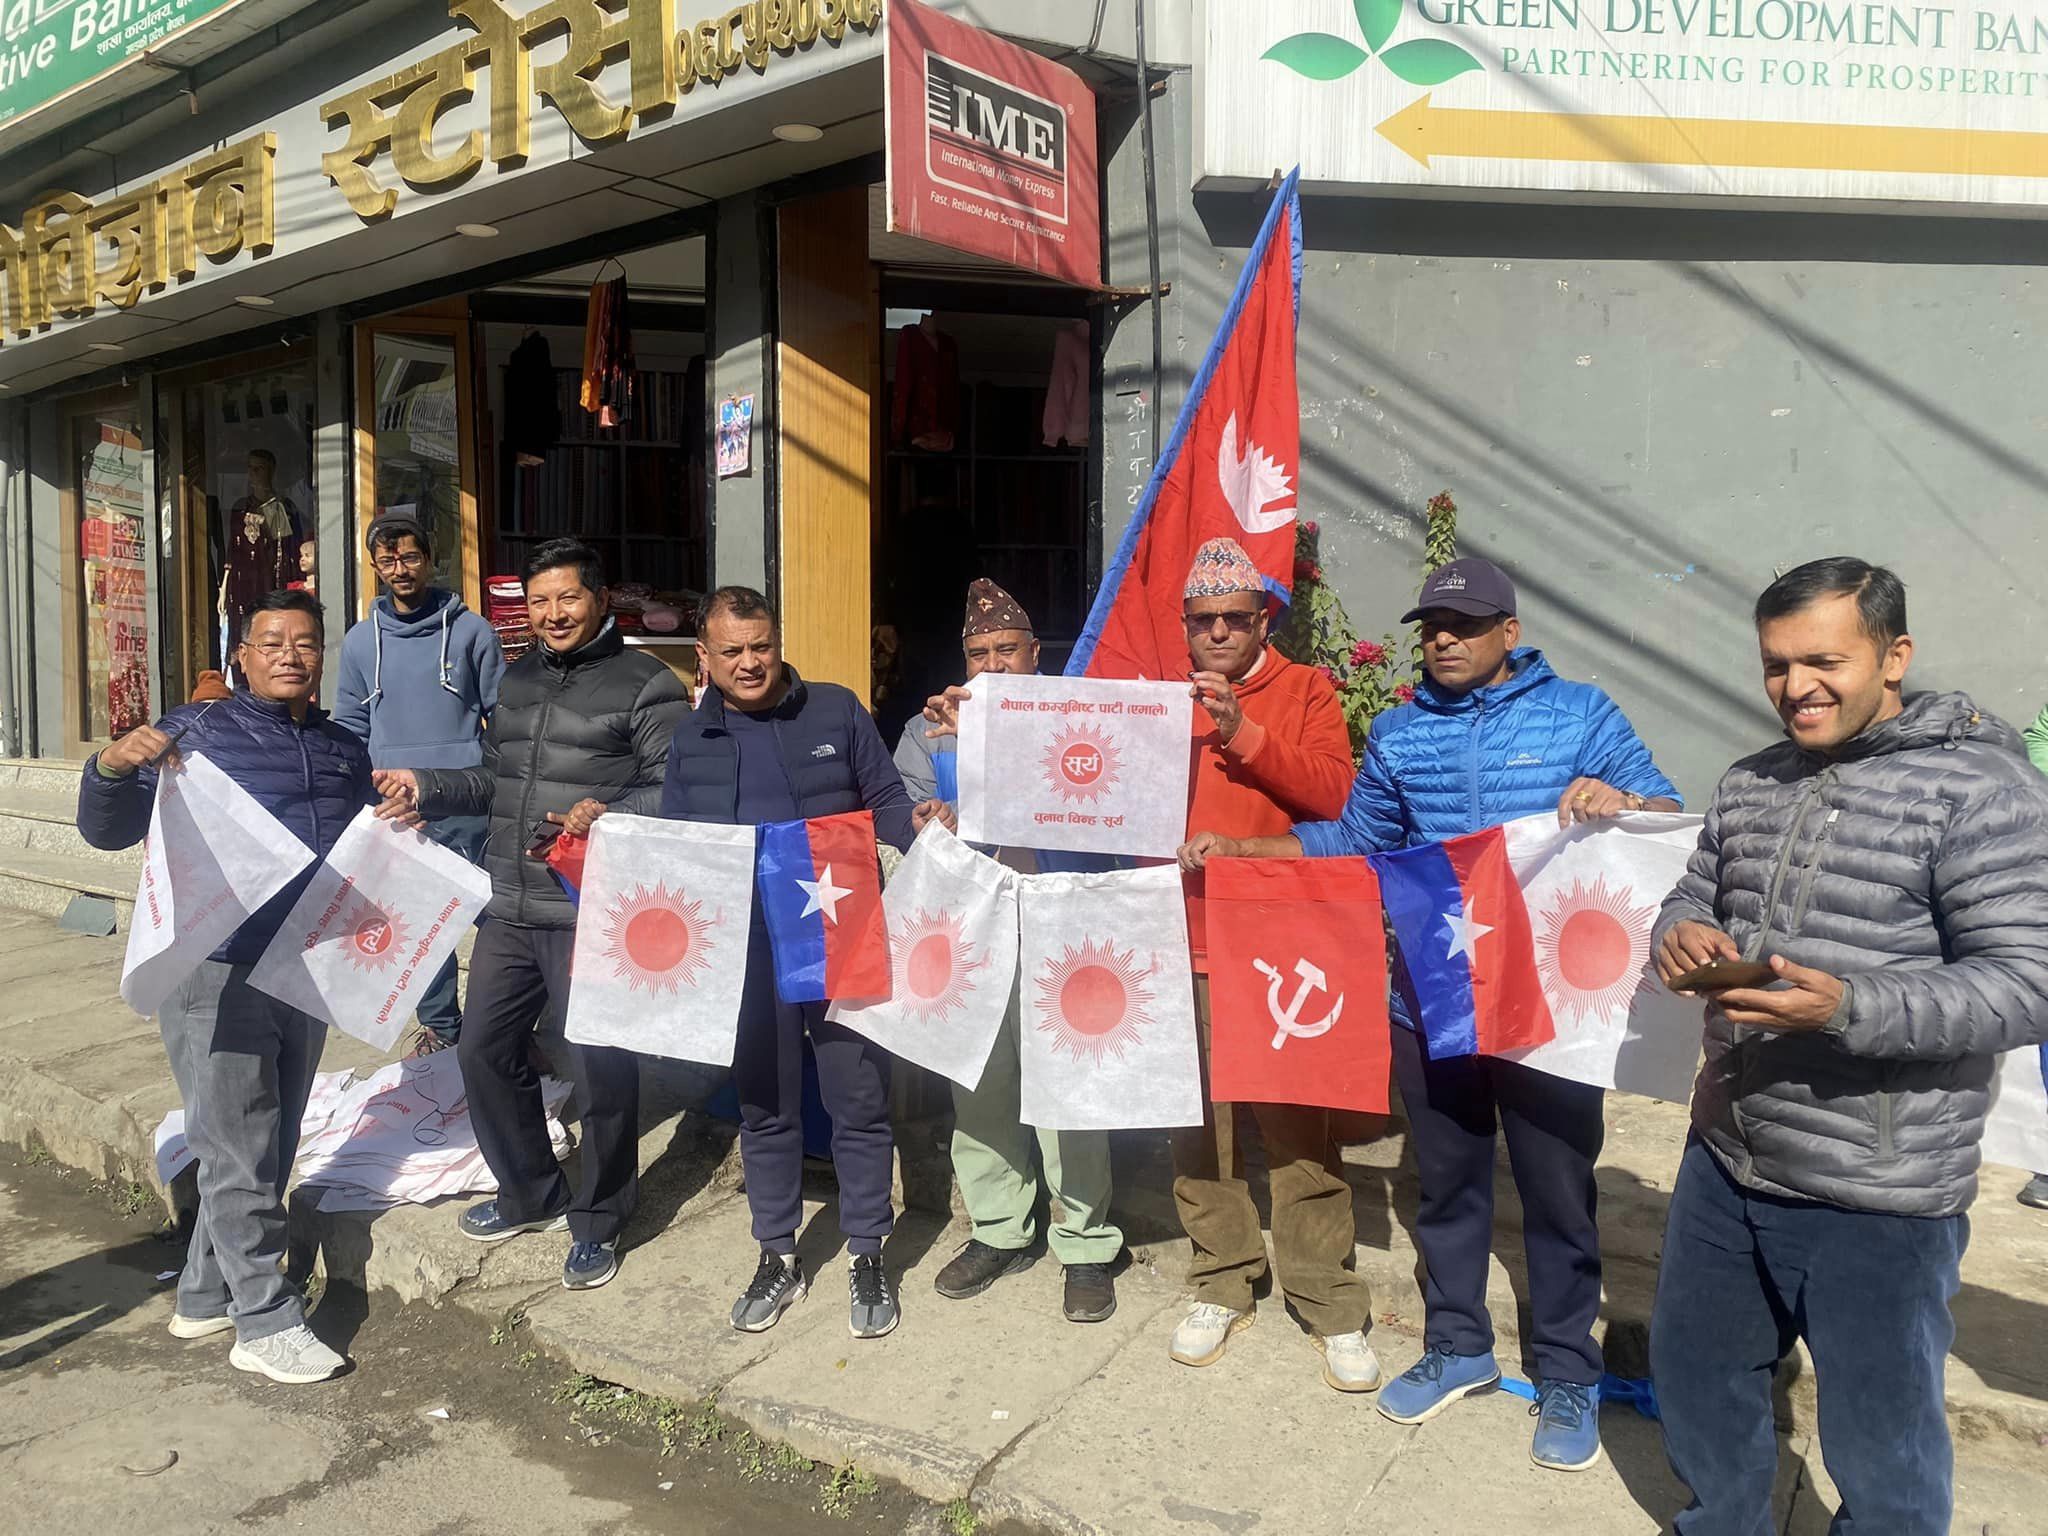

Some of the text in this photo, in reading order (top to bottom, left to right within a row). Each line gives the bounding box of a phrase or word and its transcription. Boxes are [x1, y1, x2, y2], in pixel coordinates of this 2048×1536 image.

[1417, 0, 1579, 31] GREEN
[1604, 0, 1955, 49] DEVELOPMENT
[1501, 46, 2048, 97] PARTNERING FOR PROSPERIT
[952, 83, 1054, 170] IME
[941, 147, 1056, 200] International Money Express
[951, 197, 983, 218] Reliable
[983, 207, 999, 223] And
[1000, 214, 1025, 231] Secure
[1026, 220, 1066, 244] Remittance
[1000, 697, 1034, 712] नेपाल
[1063, 754, 1100, 777] सूर्य
[1033, 812, 1064, 825] चुनाव
[1103, 814, 1125, 829] सूर्य
